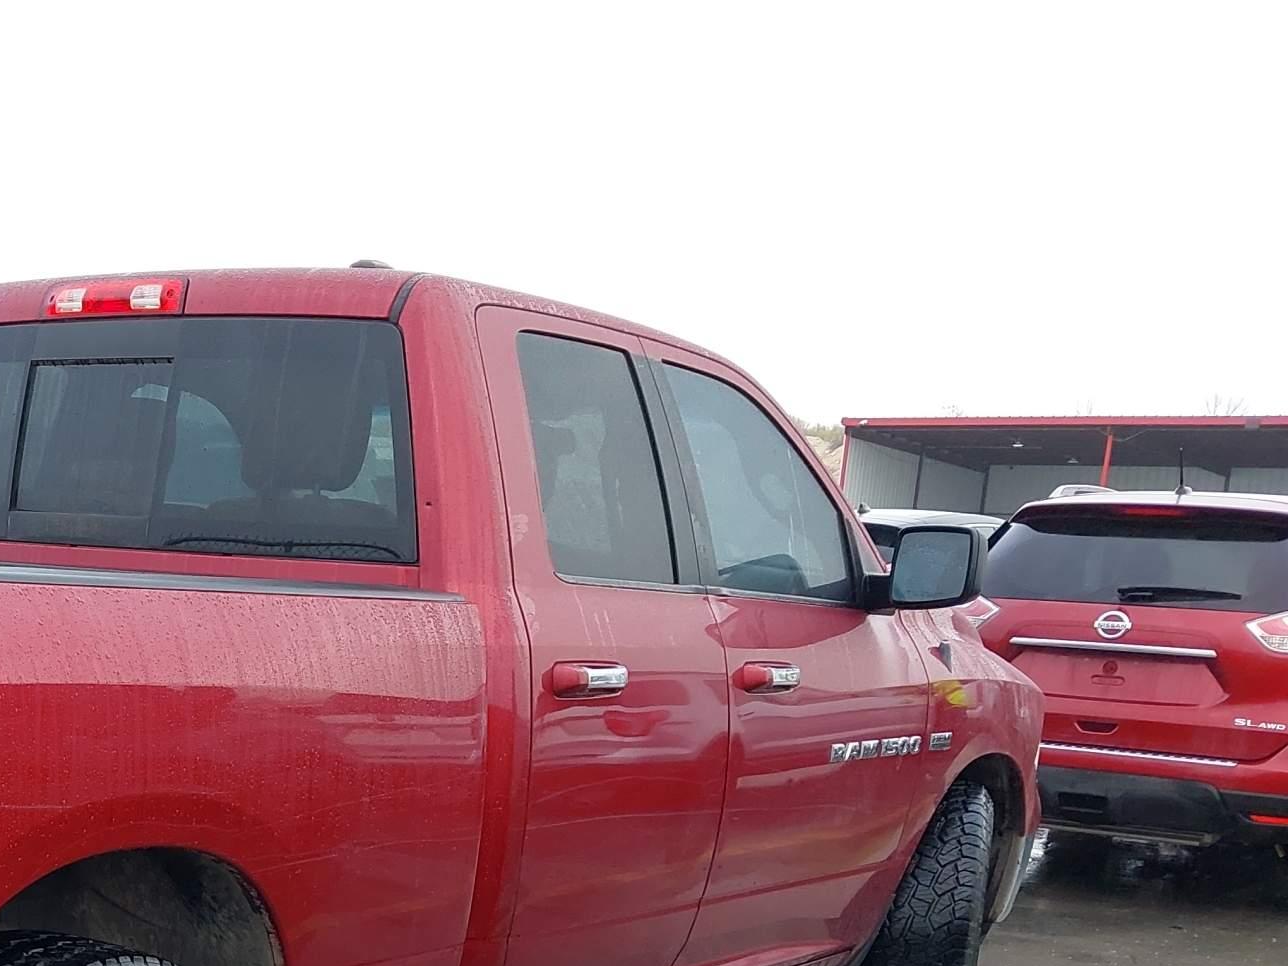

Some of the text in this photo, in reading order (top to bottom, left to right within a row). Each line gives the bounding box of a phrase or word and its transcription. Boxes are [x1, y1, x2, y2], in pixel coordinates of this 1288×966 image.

[1234, 718, 1286, 731] SL AWD
[830, 740, 879, 762] RAM
[880, 735, 922, 757] 1500
